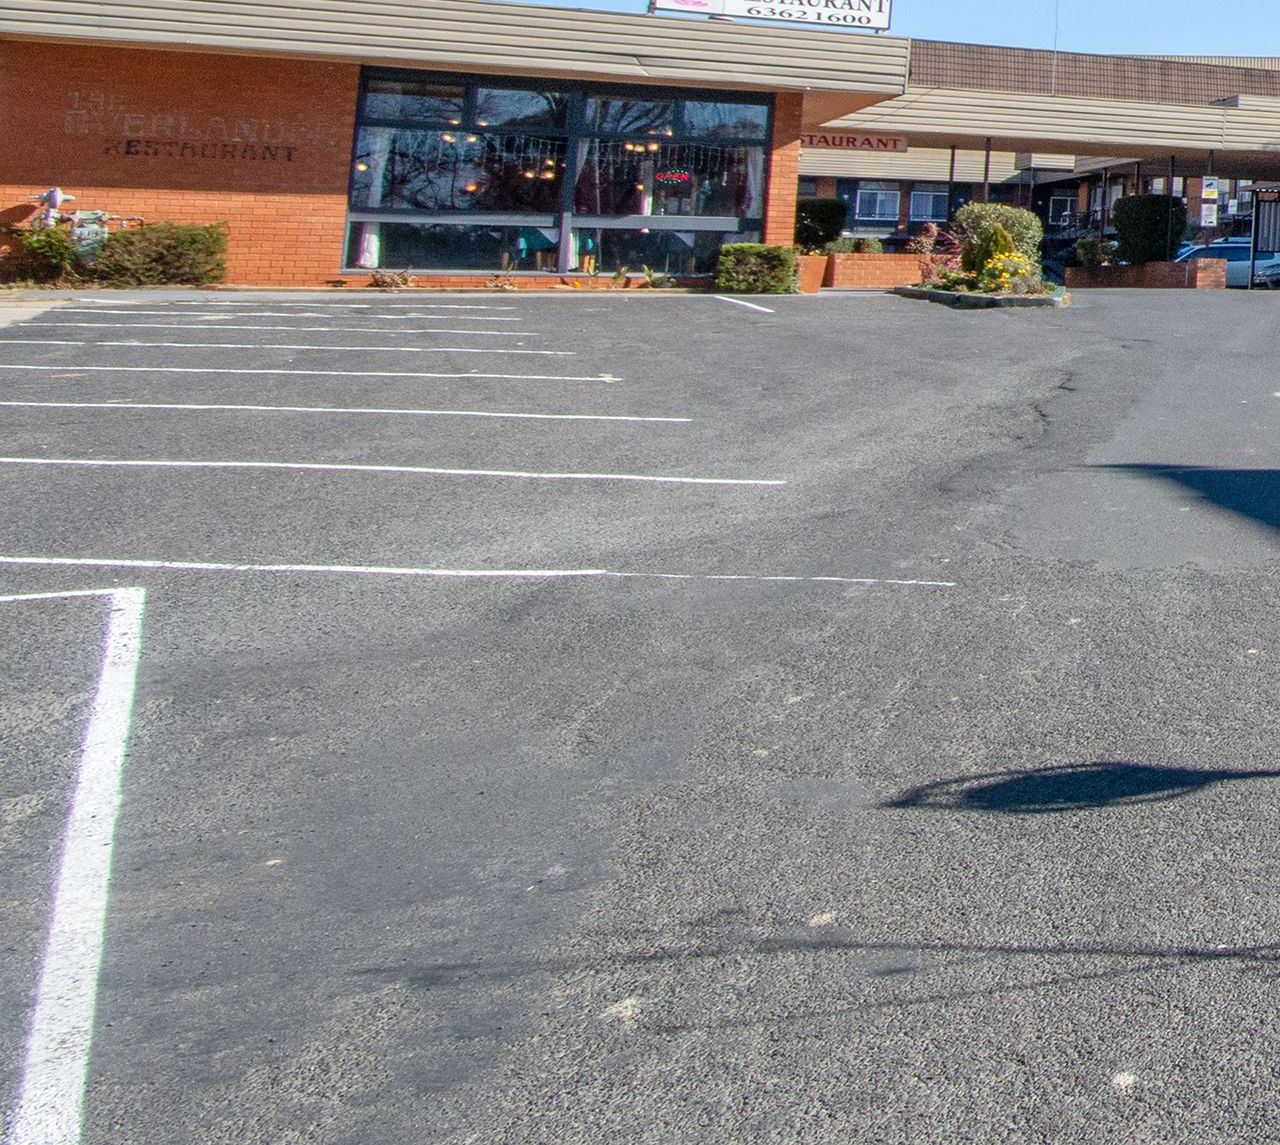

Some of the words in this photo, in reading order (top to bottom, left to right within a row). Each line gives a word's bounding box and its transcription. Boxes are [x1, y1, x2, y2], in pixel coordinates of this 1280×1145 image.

[746, 5, 809, 21] 6362
[815, 11, 872, 26] 1600
[103, 137, 299, 161] RESTAURANT
